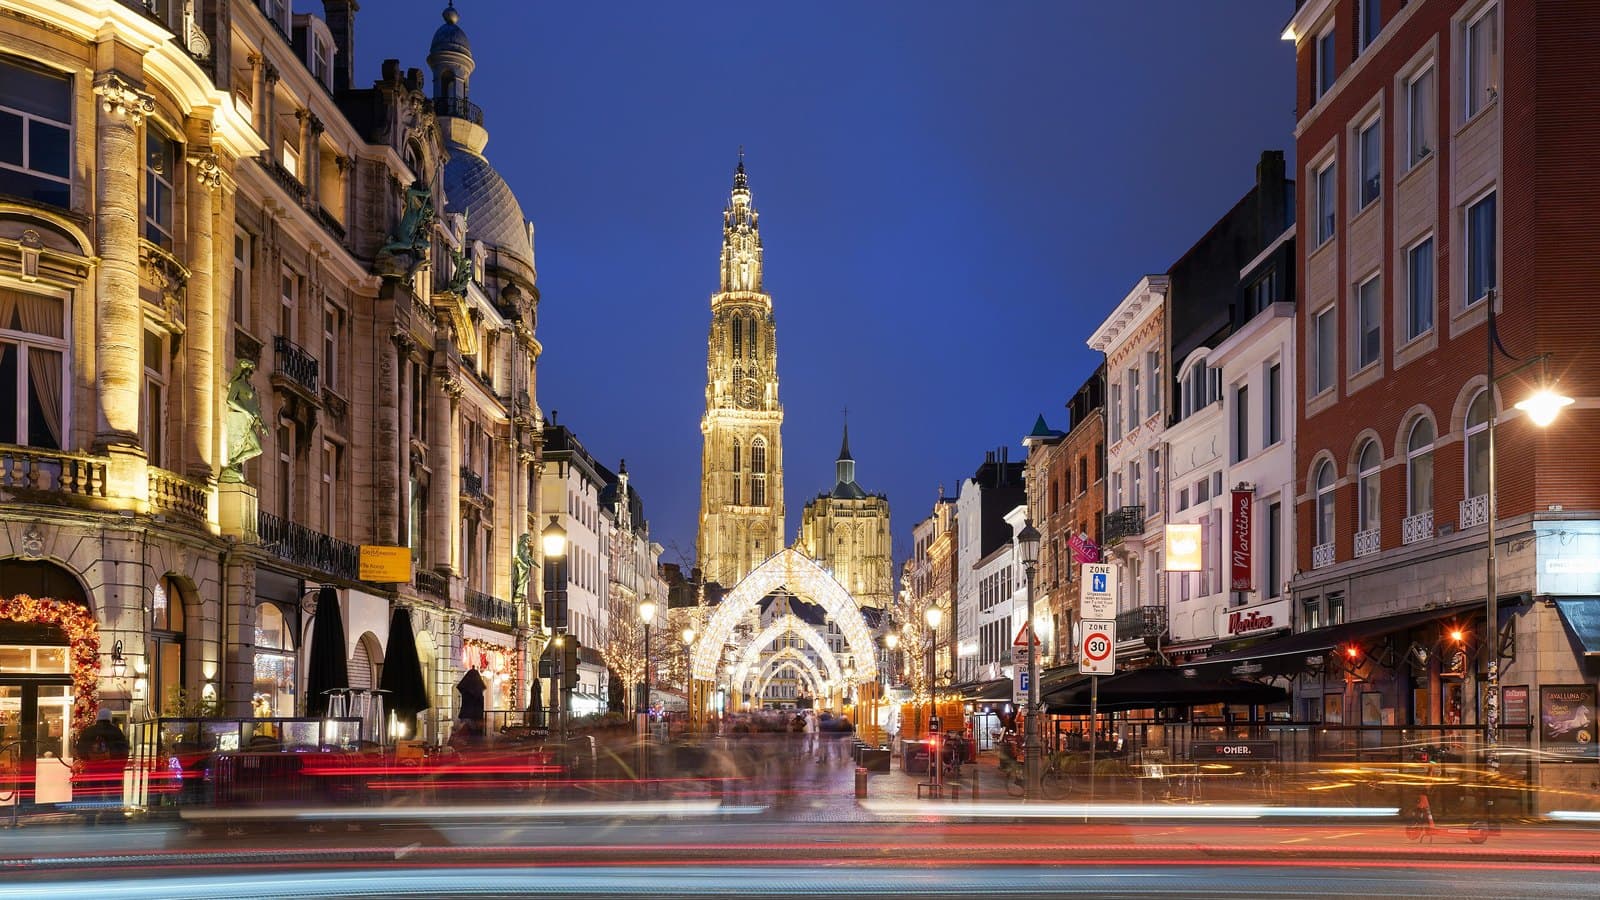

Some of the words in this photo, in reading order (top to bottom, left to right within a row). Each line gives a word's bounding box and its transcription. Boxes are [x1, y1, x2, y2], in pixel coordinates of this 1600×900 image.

[1233, 496, 1249, 569] Maritime
[1072, 536, 1097, 559] WALLS
[1090, 566, 1111, 574] ZONE
[1228, 610, 1274, 635] Maritime
[1090, 641, 1105, 652] 30
